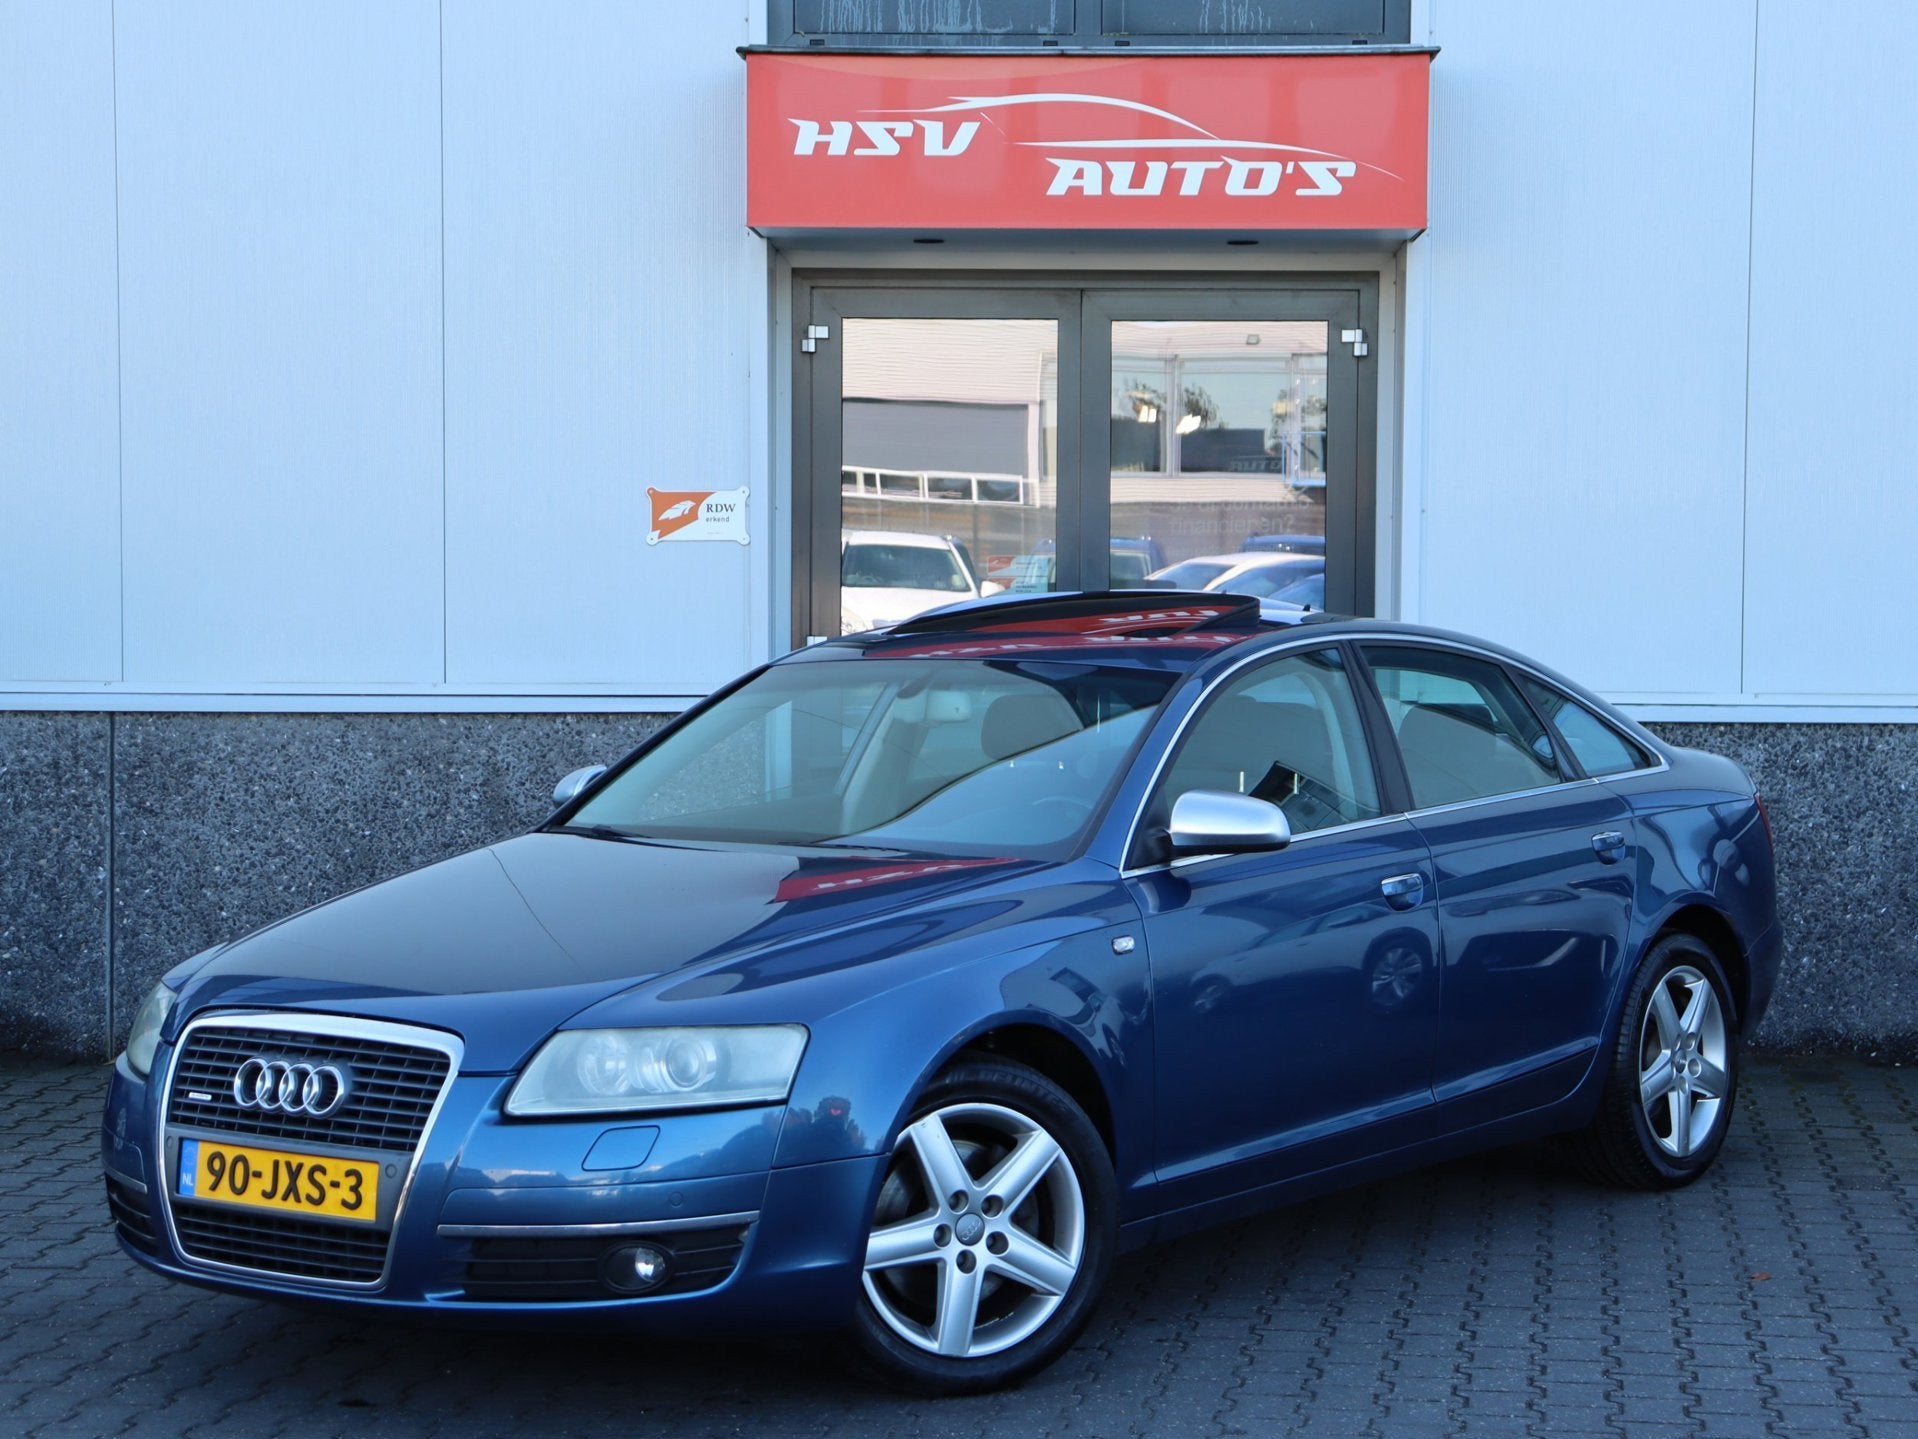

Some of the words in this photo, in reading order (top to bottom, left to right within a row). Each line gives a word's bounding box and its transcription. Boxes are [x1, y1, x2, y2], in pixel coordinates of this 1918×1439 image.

[788, 118, 981, 157] HSV
[1045, 155, 1357, 197] AUTO'S
[705, 503, 736, 513] RDW
[705, 515, 730, 523] erkend
[182, 1172, 194, 1186] NL
[207, 1151, 363, 1211] 90-JXS-3
